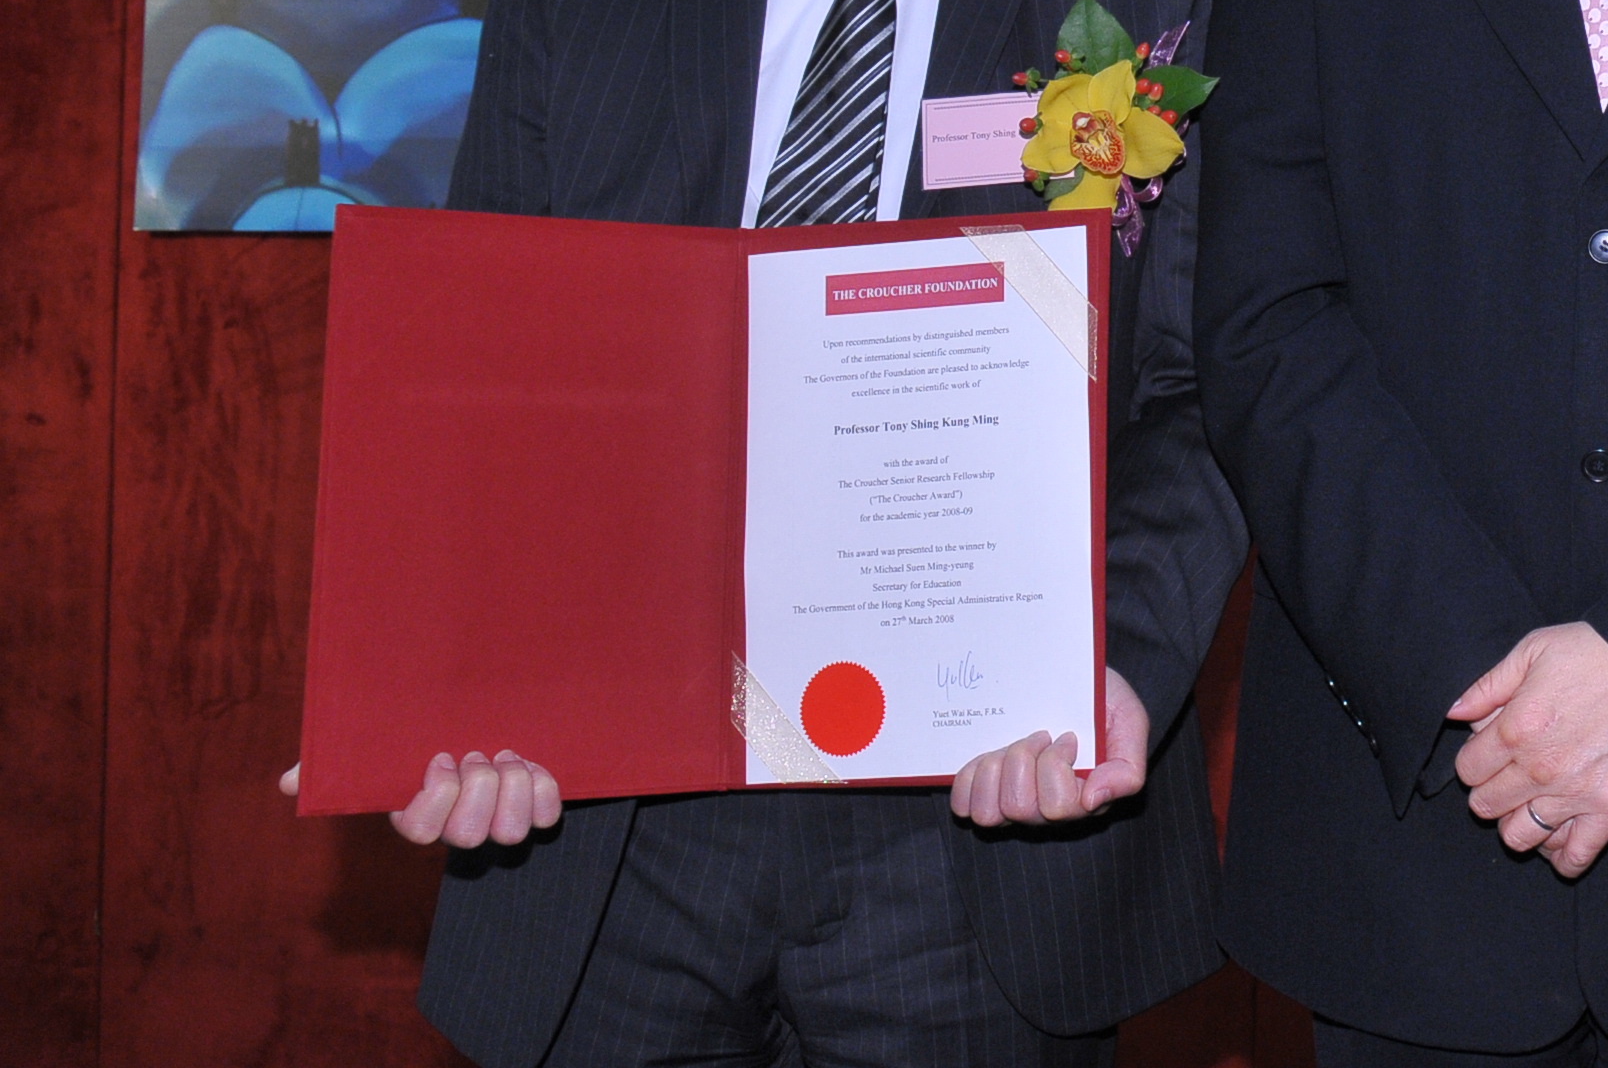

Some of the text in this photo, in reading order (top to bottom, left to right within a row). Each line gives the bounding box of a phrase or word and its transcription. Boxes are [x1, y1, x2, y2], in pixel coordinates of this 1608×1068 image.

[932, 129, 1016, 143] Professor Tony Shing
[834, 278, 998, 301] THE CROUCHER FOUNDATION
[823, 327, 1010, 350] Upon recommendations by distinguished members
[841, 346, 990, 364] of the international scientific community
[804, 375, 818, 384] The
[819, 374, 859, 383] Governors
[860, 371, 869, 380] of
[870, 370, 882, 379] the
[884, 368, 926, 378] Foundation
[941, 363, 969, 375] pleased
[980, 359, 1029, 370] acknowledge
[851, 379, 981, 398] excellence in the scientific work of
[834, 415, 999, 436] Professor Tony Shing Kung Ming
[883, 455, 949, 468] with the award of
[838, 470, 995, 489] The Croucher Senior Research Fellowship
[893, 493, 928, 503] Croucher
[860, 507, 973, 522] for the academic year 2008-09
[837, 550, 855, 559] This
[856, 548, 879, 558] award
[897, 544, 934, 557] presented
[935, 545, 943, 553] to
[945, 543, 957, 552] the
[987, 541, 996, 551] by
[860, 562, 974, 575] Mr Michael Suen Ming-yeung
[872, 580, 962, 592] Secretary for Education
[792, 593, 1043, 614] The Government of the Hong Kong Special Administrative Region
[908, 616, 933, 625] March
[935, 615, 955, 624] 2008
[933, 710, 950, 718] Yuet
[932, 719, 972, 728] CHAIRMAN
